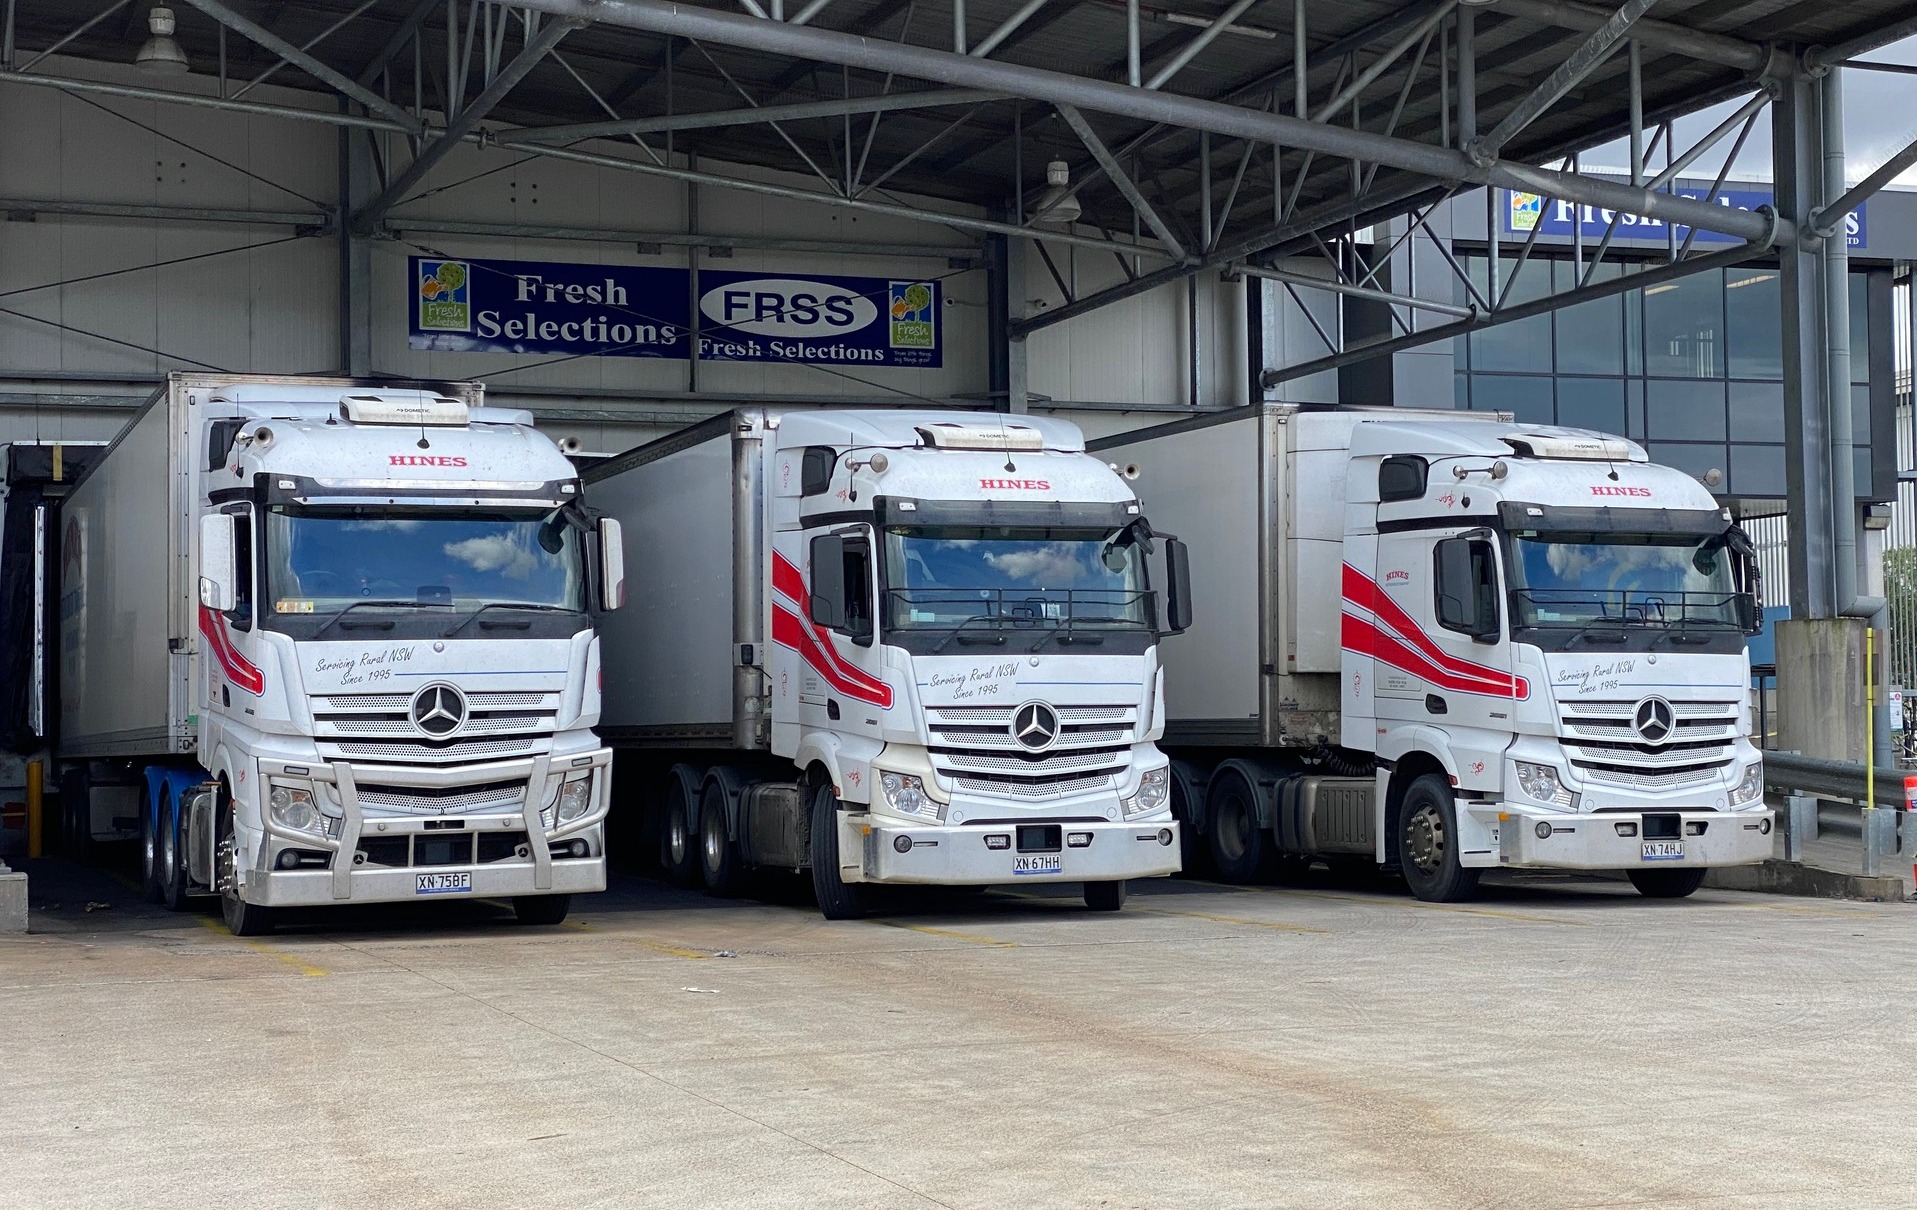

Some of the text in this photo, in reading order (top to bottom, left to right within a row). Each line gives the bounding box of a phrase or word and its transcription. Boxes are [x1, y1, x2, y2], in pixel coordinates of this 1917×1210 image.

[1846, 237, 1860, 245] TD
[514, 274, 629, 306] Fresh
[428, 303, 464, 318] Fresh
[723, 290, 855, 327] FRSS
[426, 316, 466, 328] Selections
[476, 310, 677, 345] Selections
[897, 323, 929, 336] Fresh
[697, 338, 762, 357] Fresh
[769, 341, 884, 360] Selections
[389, 455, 467, 467] HINES
[980, 479, 1050, 490] HINES
[1590, 486, 1651, 497] HINES
[1386, 570, 1409, 581] HINES
[315, 645, 415, 673] Servicing Rural NSW
[340, 669, 391, 686] Since 1995
[930, 661, 1020, 688] Servicing Rural NSW
[1557, 659, 1636, 682] Servicing Rural NSW
[953, 683, 999, 700] Since 1995
[1578, 679, 1619, 694] Since 1995
